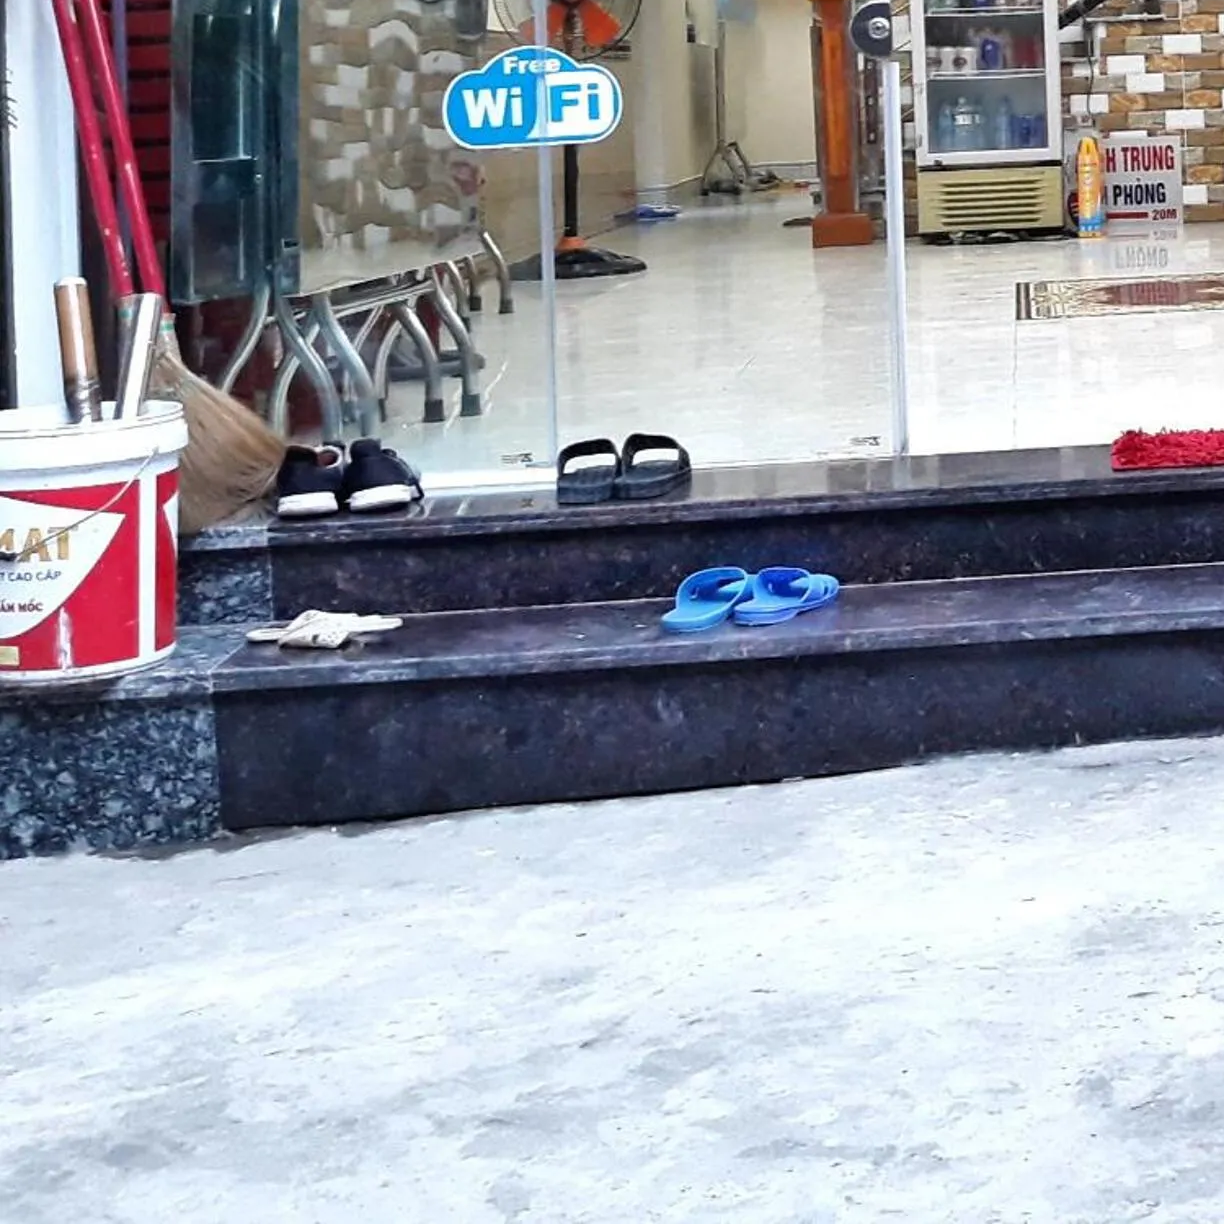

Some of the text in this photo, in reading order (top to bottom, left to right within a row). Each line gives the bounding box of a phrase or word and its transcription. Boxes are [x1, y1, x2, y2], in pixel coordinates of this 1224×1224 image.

[503, 55, 561, 75] Free
[1121, 145, 1175, 172] TRUNG
[1112, 177, 1166, 206] PHÒNG
[1152, 209, 1177, 221] 20M
[7, 571, 33, 581] CAO
